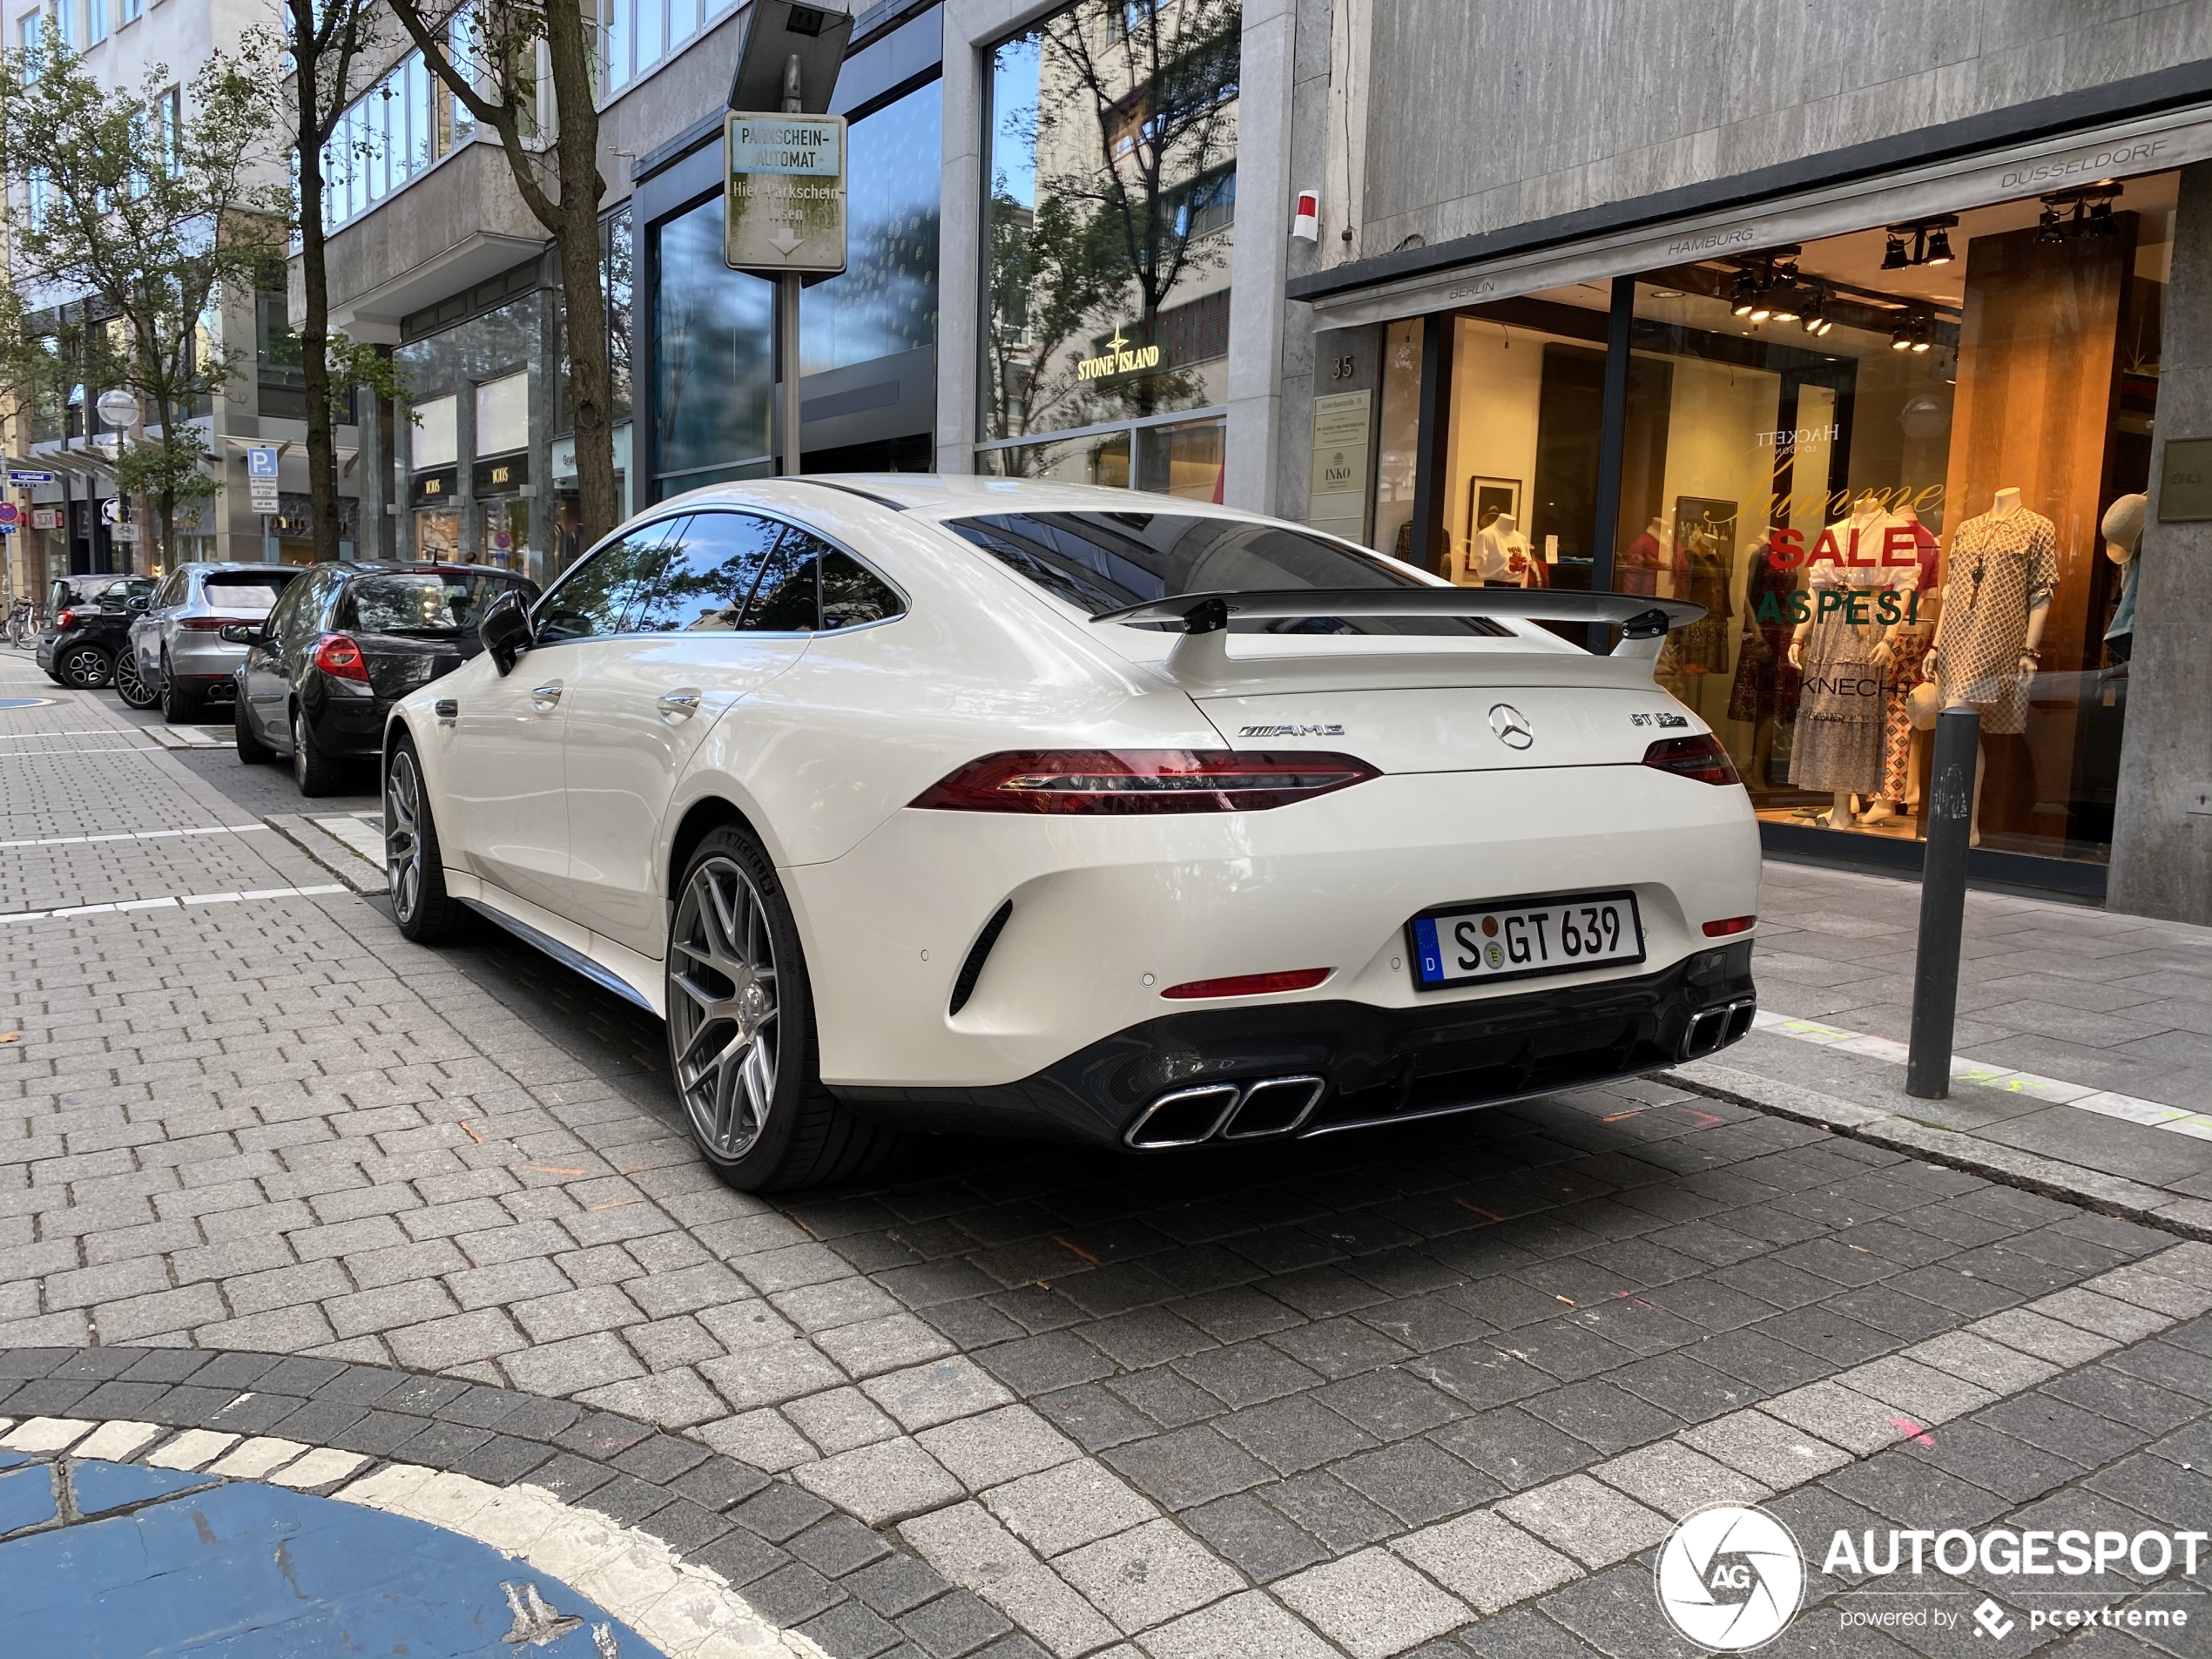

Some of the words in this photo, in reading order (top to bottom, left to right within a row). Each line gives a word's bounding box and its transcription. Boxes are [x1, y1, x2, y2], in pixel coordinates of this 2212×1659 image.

[742, 128, 830, 146] PARKSCHEIN-
[756, 152, 816, 168] AUTOMAT
[733, 181, 760, 198] Hier
[767, 182, 838, 200] Parkschein
[1668, 228, 1754, 256] HAMBURG
[1449, 280, 1495, 300] BERLIN
[1077, 354, 1115, 381] STONE
[1118, 345, 1159, 373] ISLAND
[1332, 355, 1352, 379] 35
[253, 451, 268, 473] P
[1325, 467, 1351, 481] INKO
[1703, 444, 1979, 524] Summer
[1768, 527, 1917, 570] SALE
[1755, 590, 1918, 626] ASPESI
[1799, 677, 1919, 698] KNECHT
[1629, 713, 1652, 727] GT
[1813, 714, 1844, 723] WOMEN
[728, 834, 772, 891] MICHELIN
[1454, 921, 1480, 970] S
[1504, 913, 1549, 964] GT
[1561, 906, 1620, 957] 639
[1426, 957, 1436, 972] D
